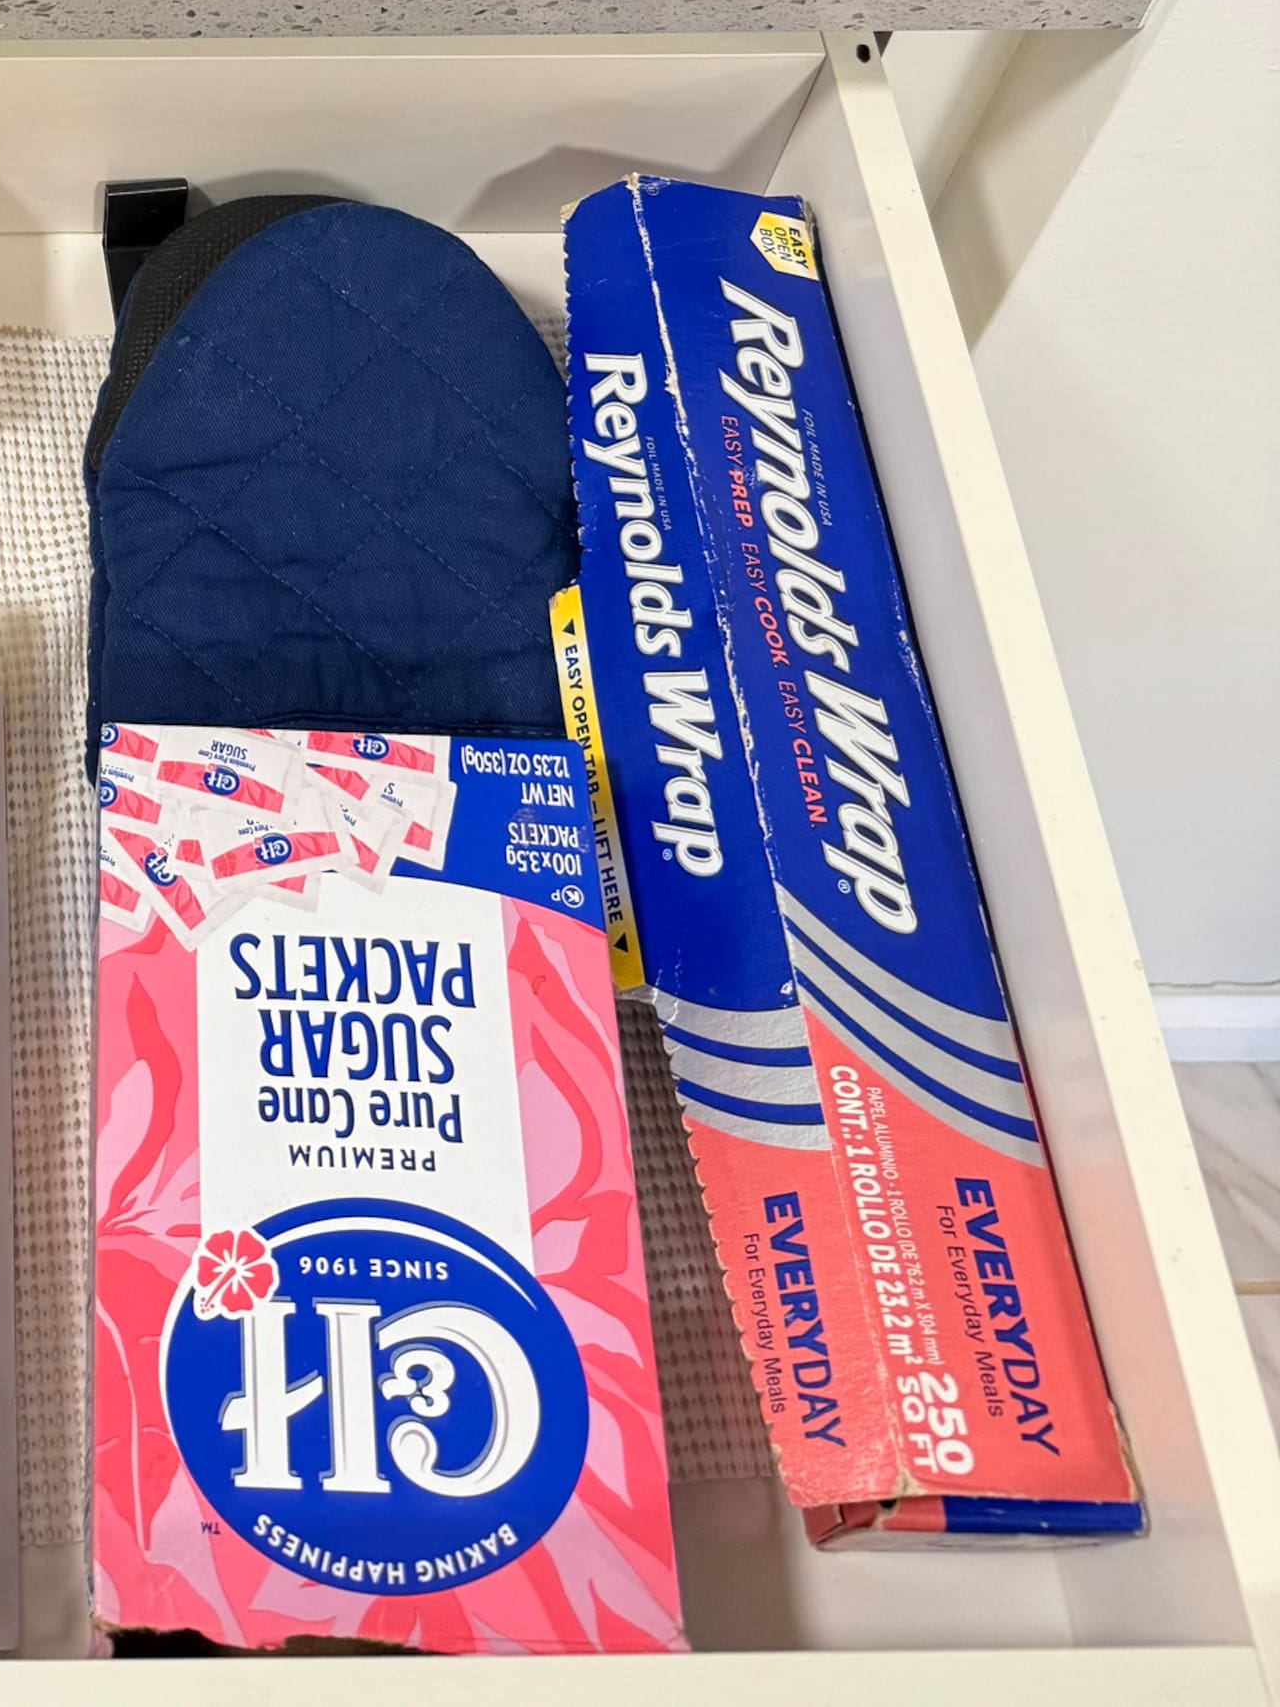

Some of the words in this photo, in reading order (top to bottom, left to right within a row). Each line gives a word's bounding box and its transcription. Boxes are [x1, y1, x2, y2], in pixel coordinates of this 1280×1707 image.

[760, 228, 776, 255] BOX
[774, 227, 793, 263] OPEN
[789, 227, 809, 270] EASY
[721, 415, 744, 466] EASY
[802, 408, 816, 440] FOIL
[645, 435, 657, 462] FOIL
[810, 442, 825, 481] MADE
[650, 464, 664, 492] MADE
[657, 494, 667, 507] IN
[728, 468, 754, 532] PREP.
[816, 482, 826, 496] IN
[661, 509, 672, 532] USA
[821, 497, 832, 527] USA
[740, 542, 768, 593] EASY
[582, 352, 693, 659] Reynolds
[643, 667, 723, 878] Wrap
[718, 275, 860, 674] Reynolds
[803, 669, 918, 934] Wrap
[754, 596, 790, 669] COOK.
[565, 644, 583, 690] EASY
[571, 694, 593, 751] OPEN
[778, 680, 806, 734] EASY
[210, 740, 248, 760] SUGAR
[461, 745, 506, 776] (350g)
[508, 753, 531, 775] OZ
[533, 754, 570, 778] 12.35
[521, 782, 545, 805] WT
[548, 784, 575, 808] NET
[792, 737, 828, 828] CLEAN.
[508, 821, 579, 848] PACKETS
[592, 816, 612, 861] LIFT
[601, 864, 624, 923] HERE
[229, 932, 477, 1009] PACKETS
[258, 1008, 455, 1084] SUGAR
[258, 1086, 355, 1139] Cane
[370, 1089, 464, 1144] Pure
[866, 1086, 887, 1120] PAPEL
[288, 1144, 437, 1172] PREMIUM
[845, 1145, 875, 1158] 1
[873, 1122, 899, 1180] ALUMINIO
[848, 1162, 892, 1240] ROLLO
[887, 1198, 912, 1238] ROLLO
[299, 1255, 358, 1277] 1906
[368, 1257, 449, 1281] SINCE
[743, 1232, 760, 1262] For
[867, 1244, 901, 1275] DE
[748, 1268, 774, 1351] Everyday
[763, 1191, 846, 1448] EVERYDAY
[874, 1279, 914, 1329] 23.2
[936, 1204, 957, 1239] For
[947, 1246, 985, 1344] Everyday
[974, 1350, 1003, 1418] Meals
[954, 1177, 1060, 1457] EVERYDAY
[219, 1295, 541, 1498] C&H
[764, 1358, 785, 1413] Meals
[896, 1375, 926, 1424] SQ
[919, 1372, 975, 1475] 250
[908, 1432, 939, 1475] FT
[200, 1520, 221, 1536] TM
[252, 1513, 406, 1585] HAPPINESS
[416, 1521, 519, 1584] BAKING
